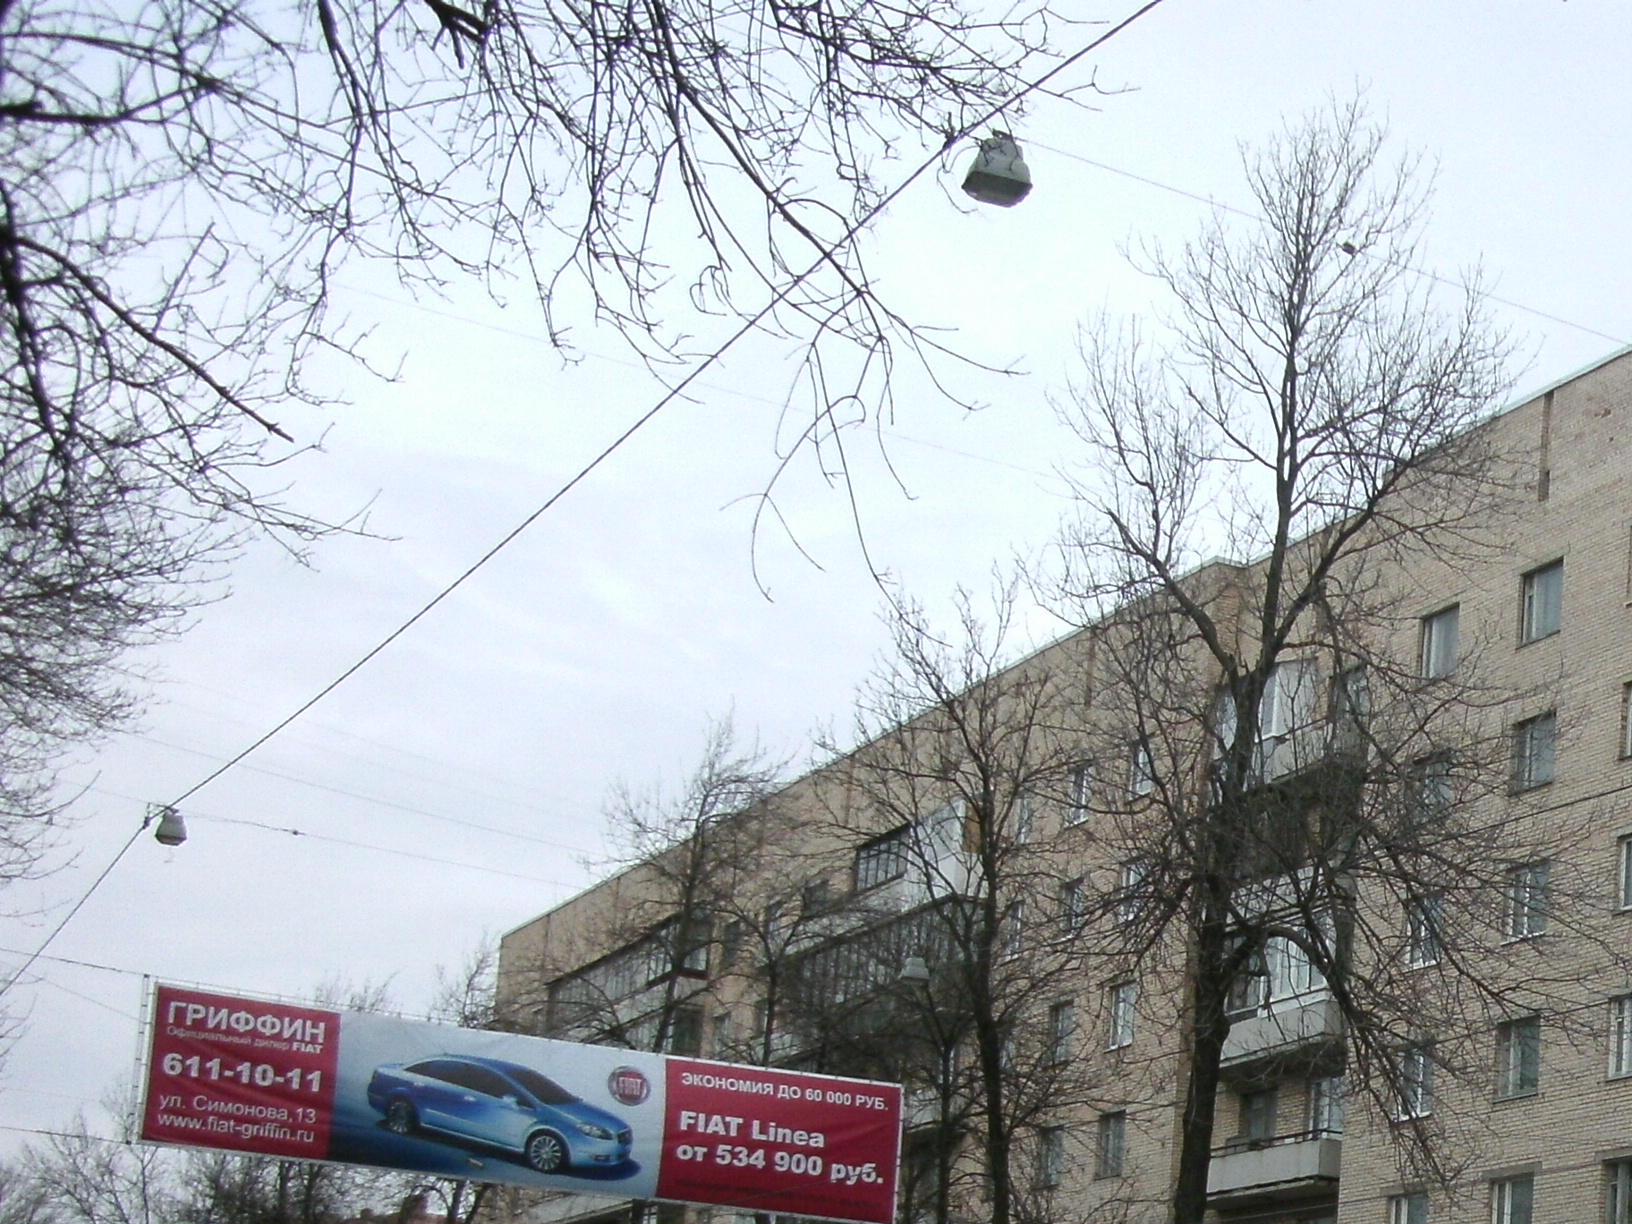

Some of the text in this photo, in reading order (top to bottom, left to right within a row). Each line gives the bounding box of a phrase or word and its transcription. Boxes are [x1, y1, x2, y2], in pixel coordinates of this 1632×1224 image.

[167, 1025, 251, 1044] Официальный
[292, 1041, 323, 1054] FIAT
[168, 1001, 325, 1042] ГРИФФИН
[163, 1053, 322, 1092] 611-10-11
[618, 1076, 643, 1096] FIAT
[681, 1072, 889, 1111] ЭКОНОМИЯ ДО 60 000 РУБ.
[159, 1094, 186, 1110] ул.
[158, 1113, 315, 1143] www.fiat-griffin.ru
[679, 1110, 825, 1148] FIAT Linea
[677, 1145, 884, 1186] от 534 900 руб.
